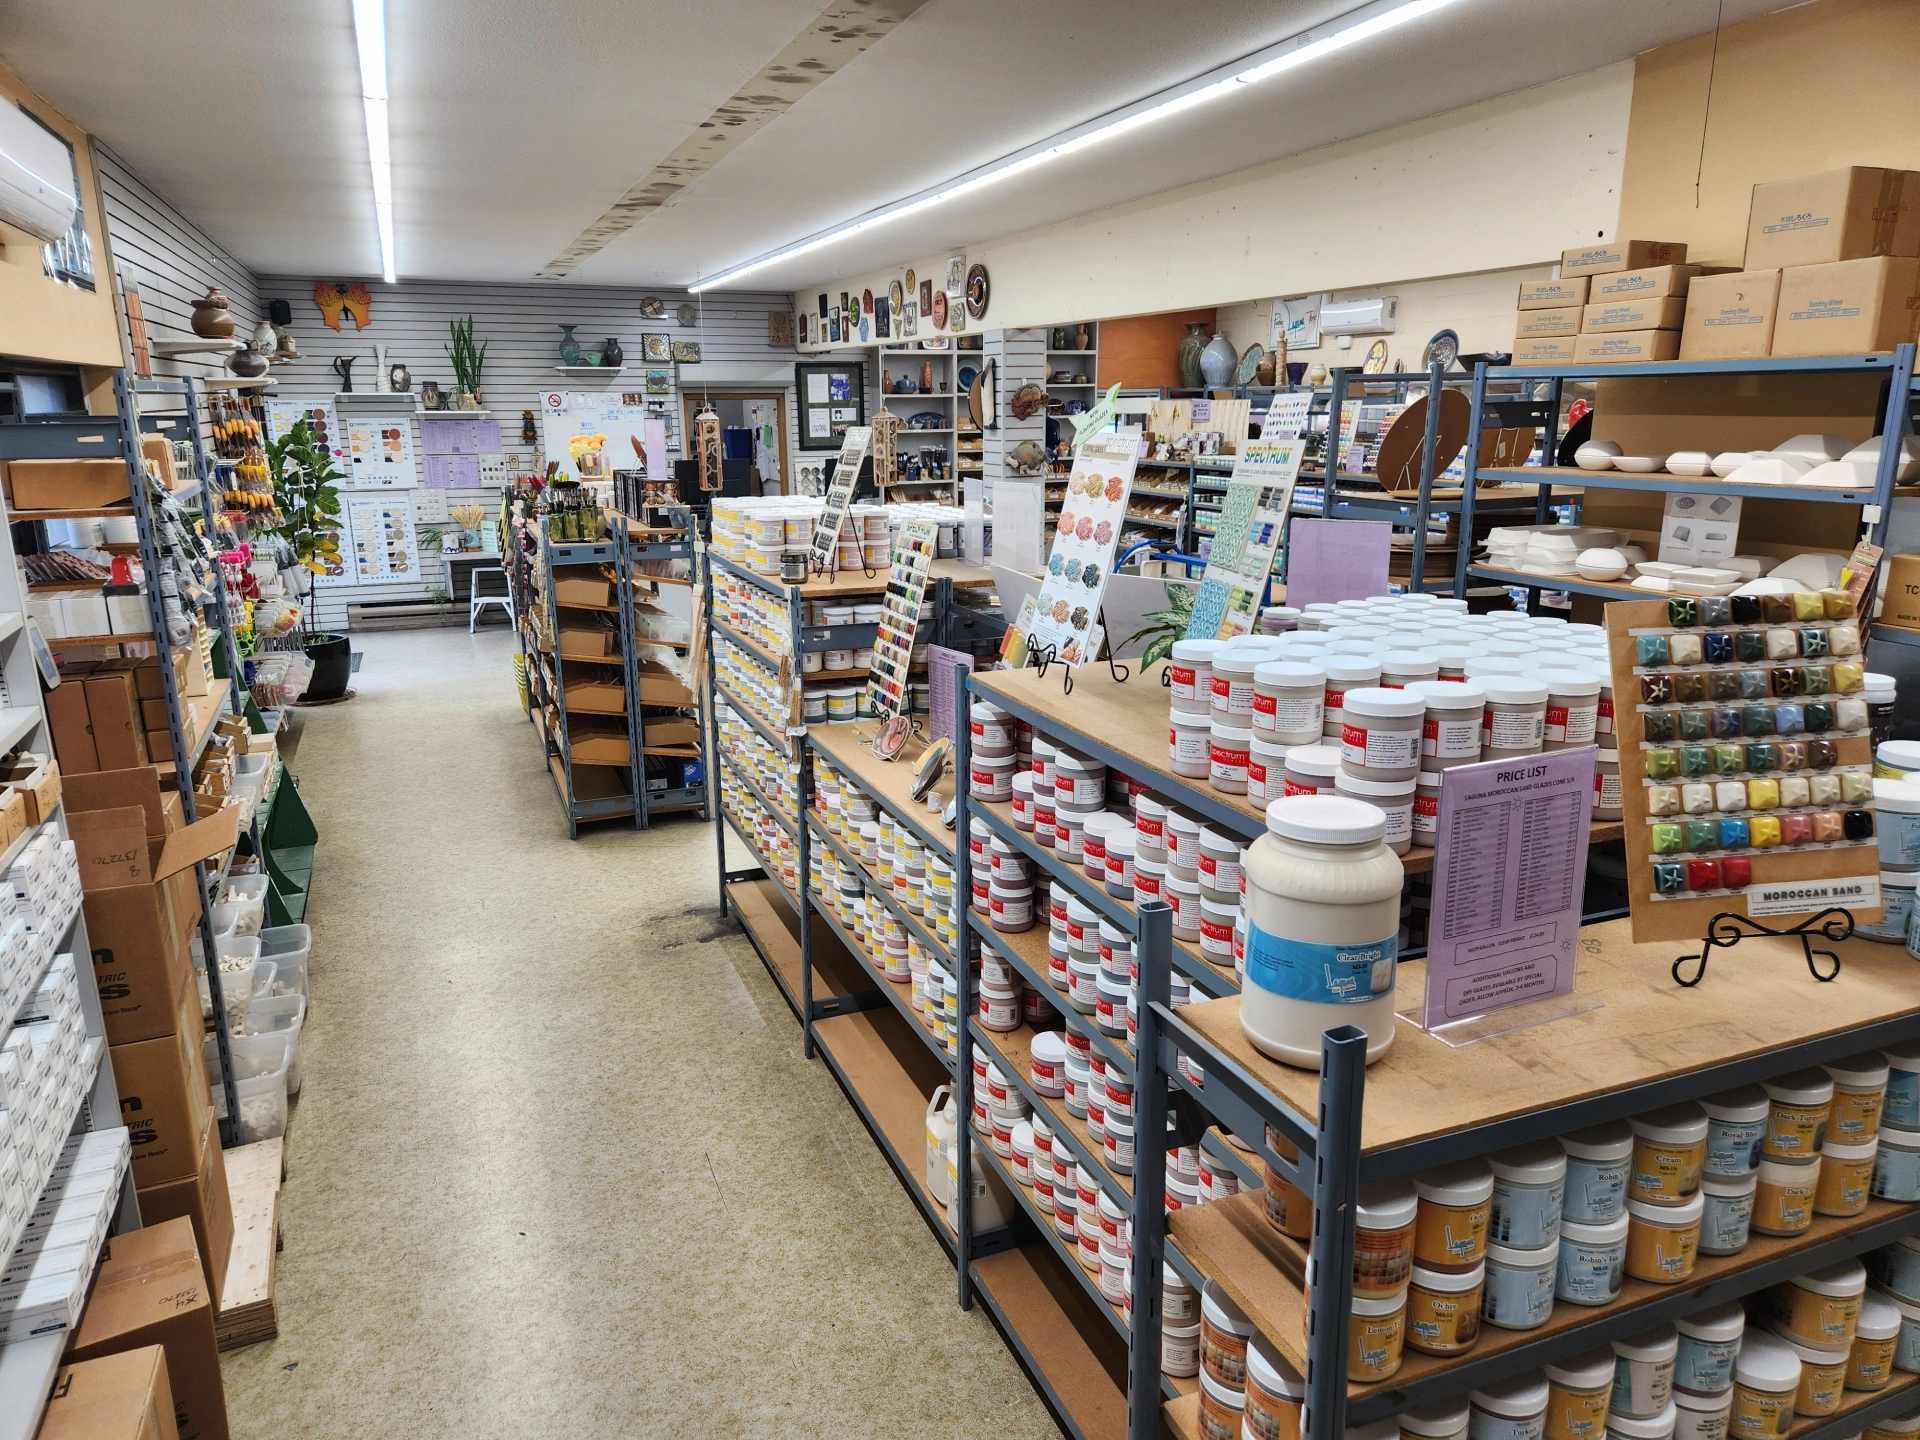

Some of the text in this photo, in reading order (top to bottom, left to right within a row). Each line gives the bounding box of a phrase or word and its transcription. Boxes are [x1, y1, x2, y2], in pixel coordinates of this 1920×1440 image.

[1244, 446, 1292, 464] SPECTRUM
[1905, 584, 1920, 595] TC
[1171, 668, 1191, 679] ctrum
[1341, 726, 1362, 739] ctrum
[1211, 748, 1245, 759] spectrum
[1497, 766, 1548, 783] PRICE LIST
[1464, 776, 1575, 801] LAGUNA MOROCCAN SAND GLAZES CONE 5/6
[1763, 885, 1862, 901] MOROCCAN SAND
[1510, 936, 1525, 944] BRIGHT
[1337, 950, 1381, 962] Clear Bright
[1472, 963, 1536, 983] ADDITIONAL GALLONS AND
[1463, 989, 1472, 997] DRY
[1473, 984, 1491, 993] GLAZES
[1492, 978, 1516, 989] AVAILABLE
[1524, 972, 1542, 981] SPECIAL
[1477, 992, 1494, 1001] ALLOW
[1524, 979, 1545, 989] MONTHS
[1776, 1111, 1796, 1121] Dark
[1721, 1130, 1742, 1139] Royal
[1655, 1154, 1682, 1164] Cream
[1598, 1170, 1623, 1182] Robin's
[1578, 1254, 1607, 1264] Robin's
[1432, 1301, 1458, 1310] Ochre
[1366, 1324, 1392, 1334] Lemon
